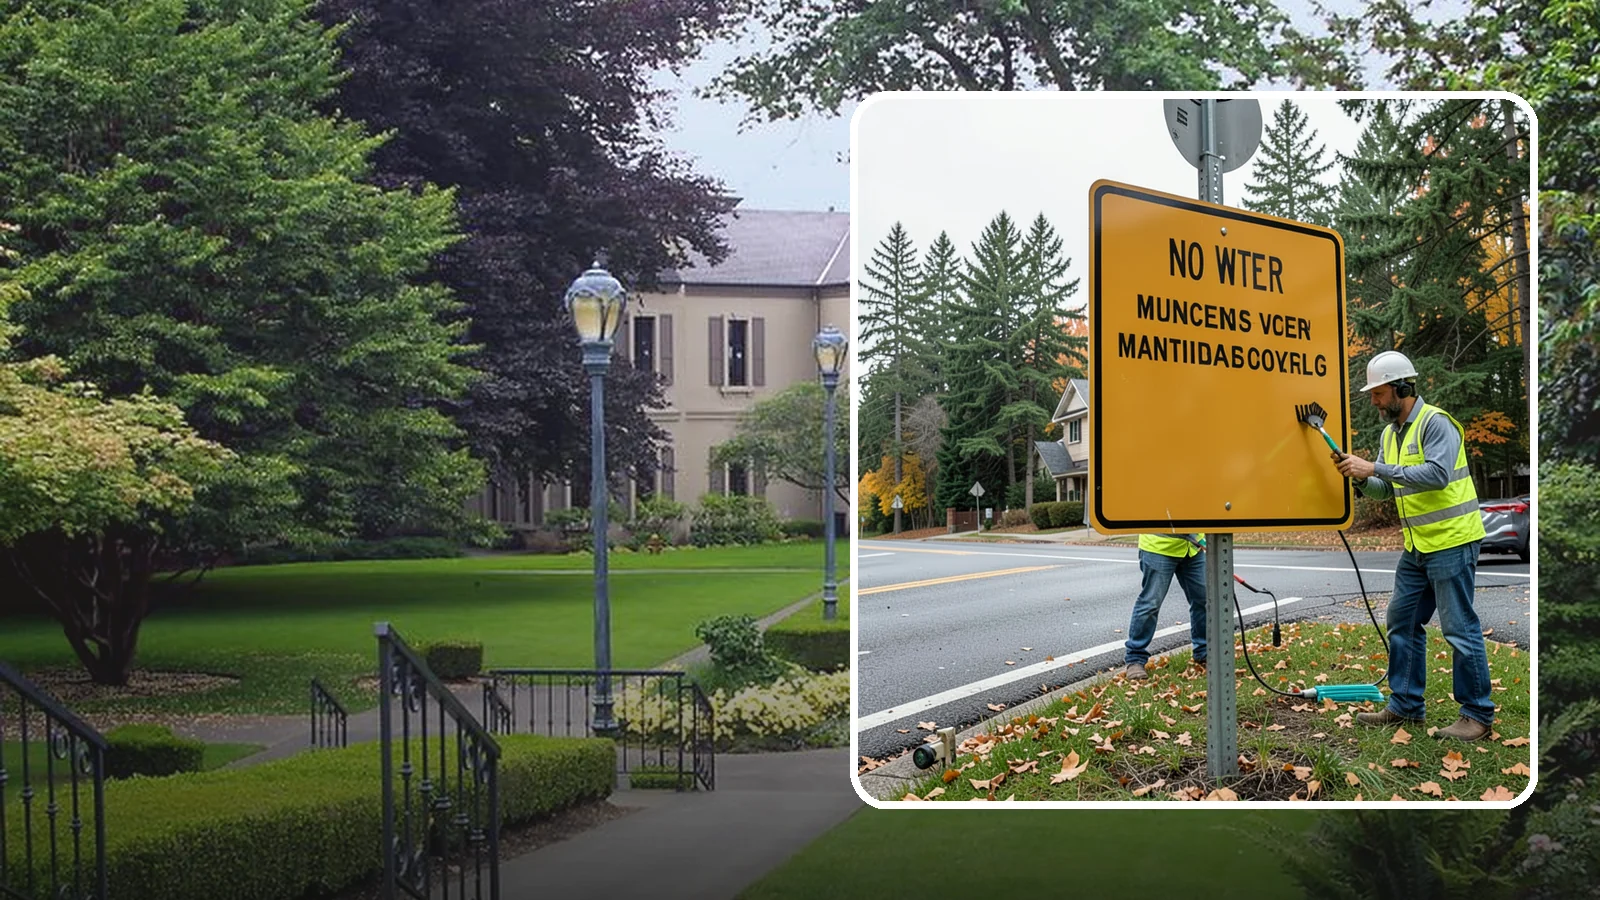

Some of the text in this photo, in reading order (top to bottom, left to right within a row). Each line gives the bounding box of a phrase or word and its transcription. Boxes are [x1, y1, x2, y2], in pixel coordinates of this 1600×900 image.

[1169, 238, 1284, 295] NO WTER
[1136, 293, 1252, 333] MUNCENS
